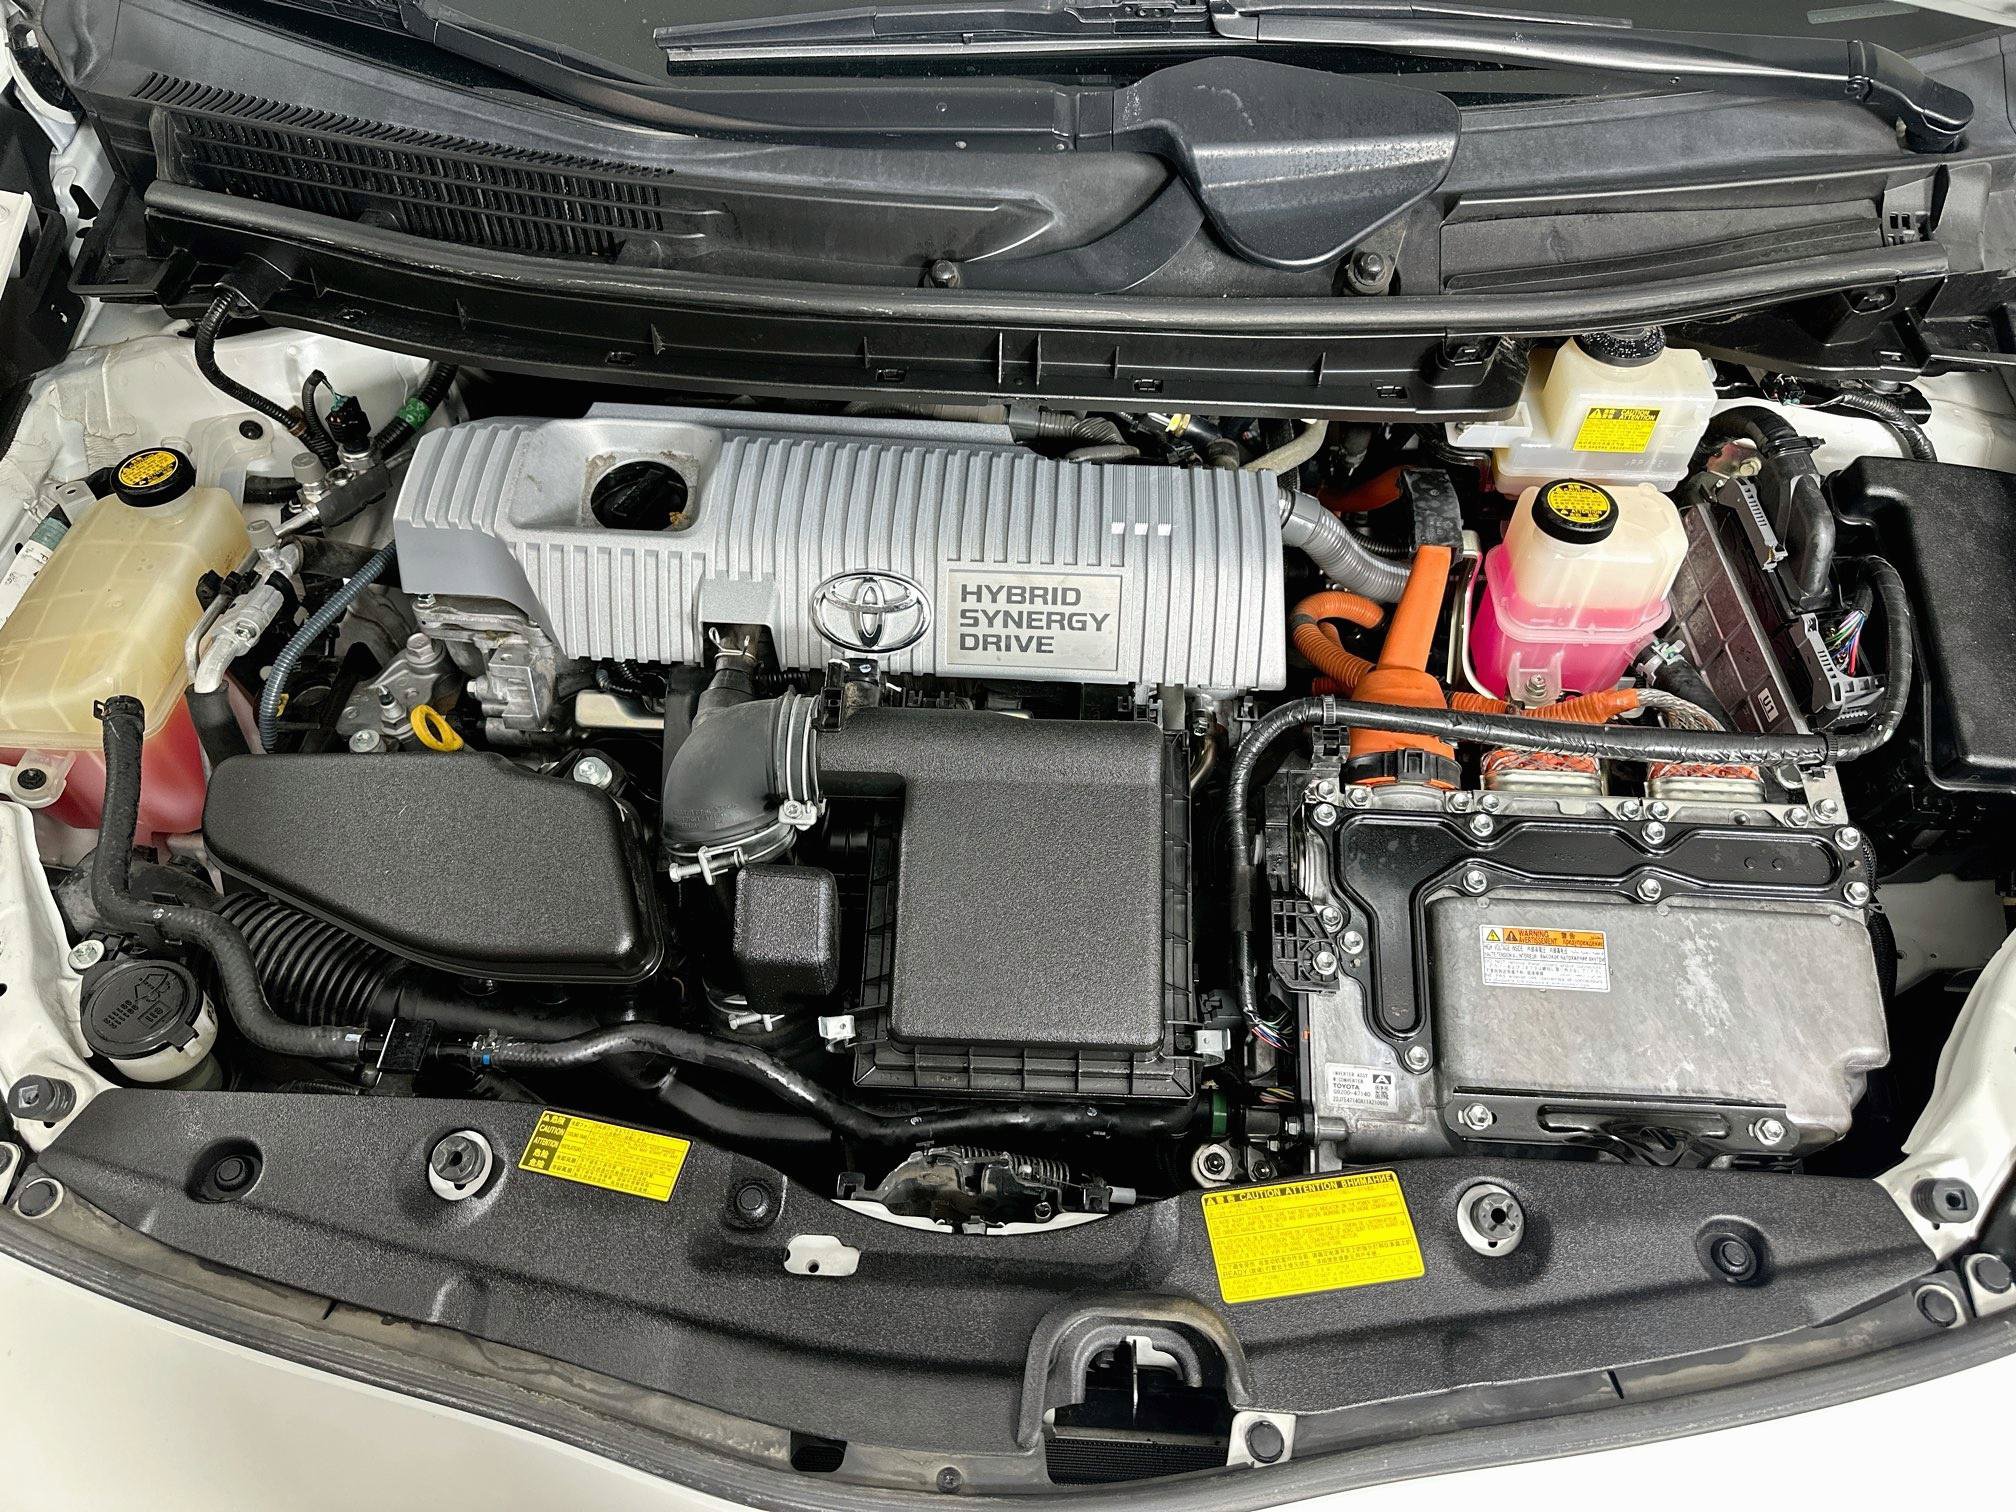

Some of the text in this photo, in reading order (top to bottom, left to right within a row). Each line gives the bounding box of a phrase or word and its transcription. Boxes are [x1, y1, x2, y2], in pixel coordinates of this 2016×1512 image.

[961, 584, 1082, 607] HYBRID
[959, 609, 1111, 632] SYNERGY
[959, 633, 1055, 654] DRIVE
[1519, 930, 1549, 938] WARNING
[539, 1124, 566, 1136] CAUTION
[1239, 1188, 1281, 1201] CAUTION
[1286, 1181, 1338, 1196] ATTENTION
[1342, 1174, 1393, 1188] ВНИМАНИЕ
